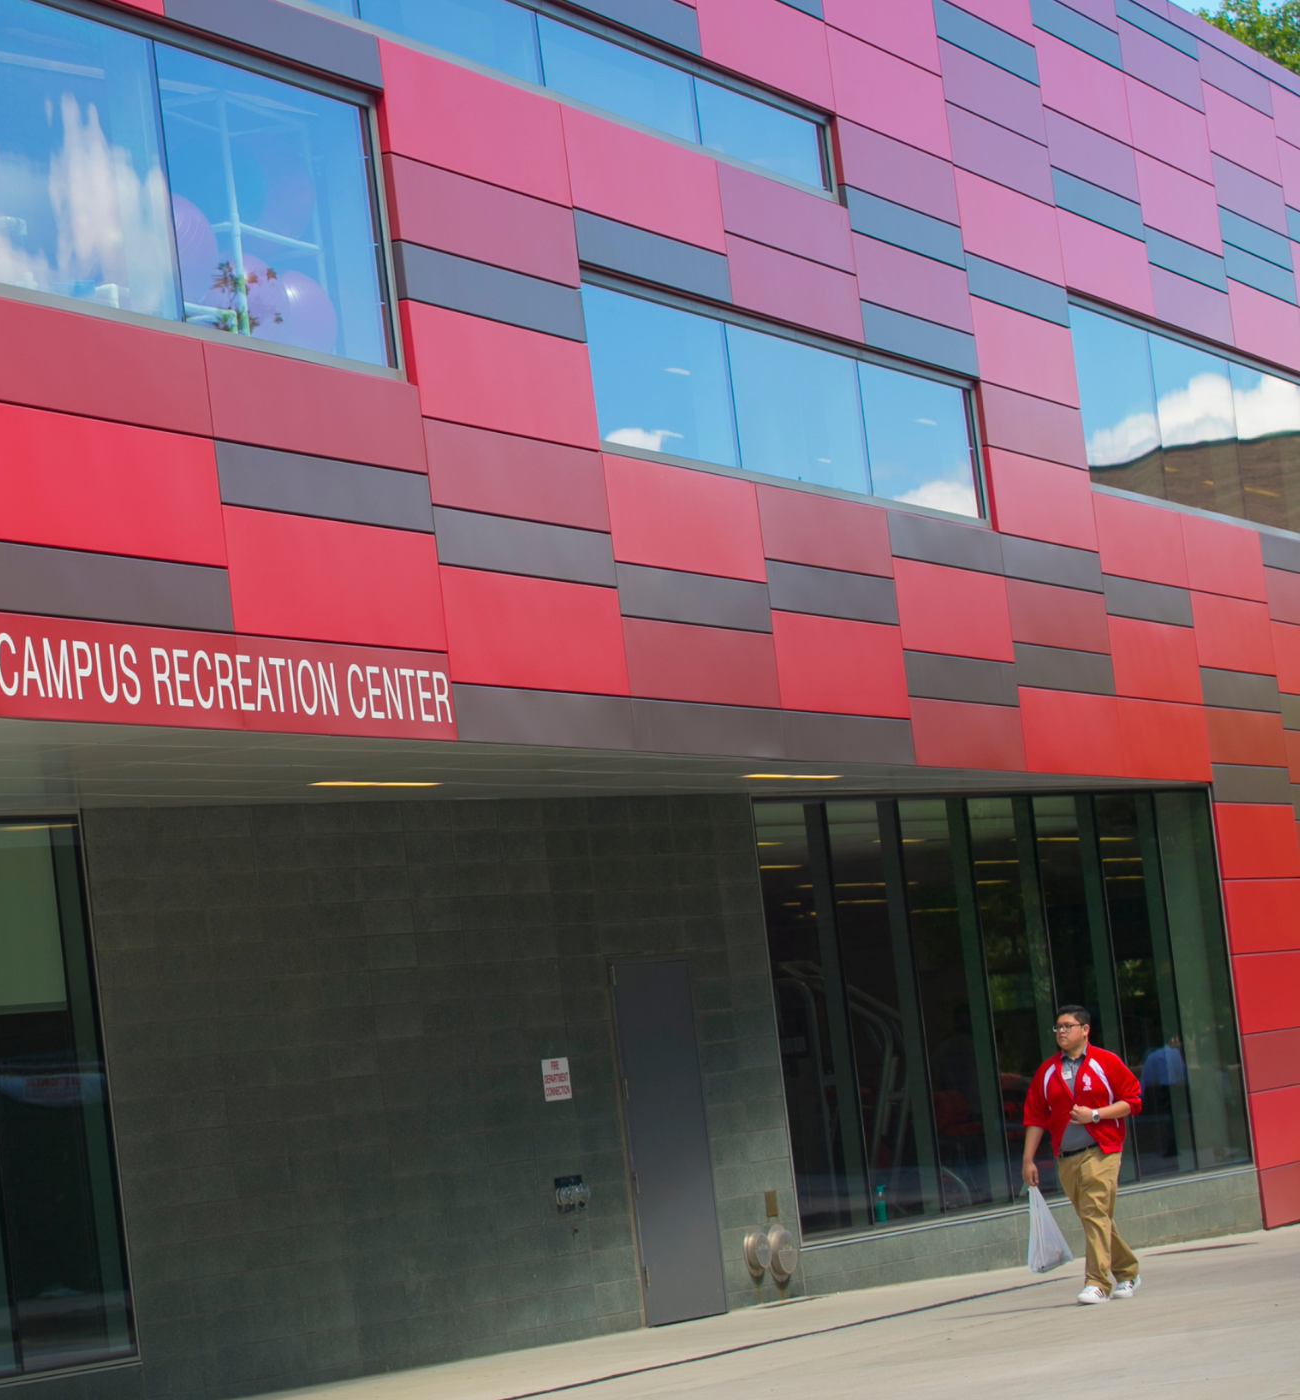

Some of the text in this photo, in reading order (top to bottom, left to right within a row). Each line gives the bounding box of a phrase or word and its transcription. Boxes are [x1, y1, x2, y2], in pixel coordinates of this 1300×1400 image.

[150, 647, 340, 717] RECREATION
[347, 663, 453, 724] CENTER
[550, 1060, 560, 1071] FIRE
